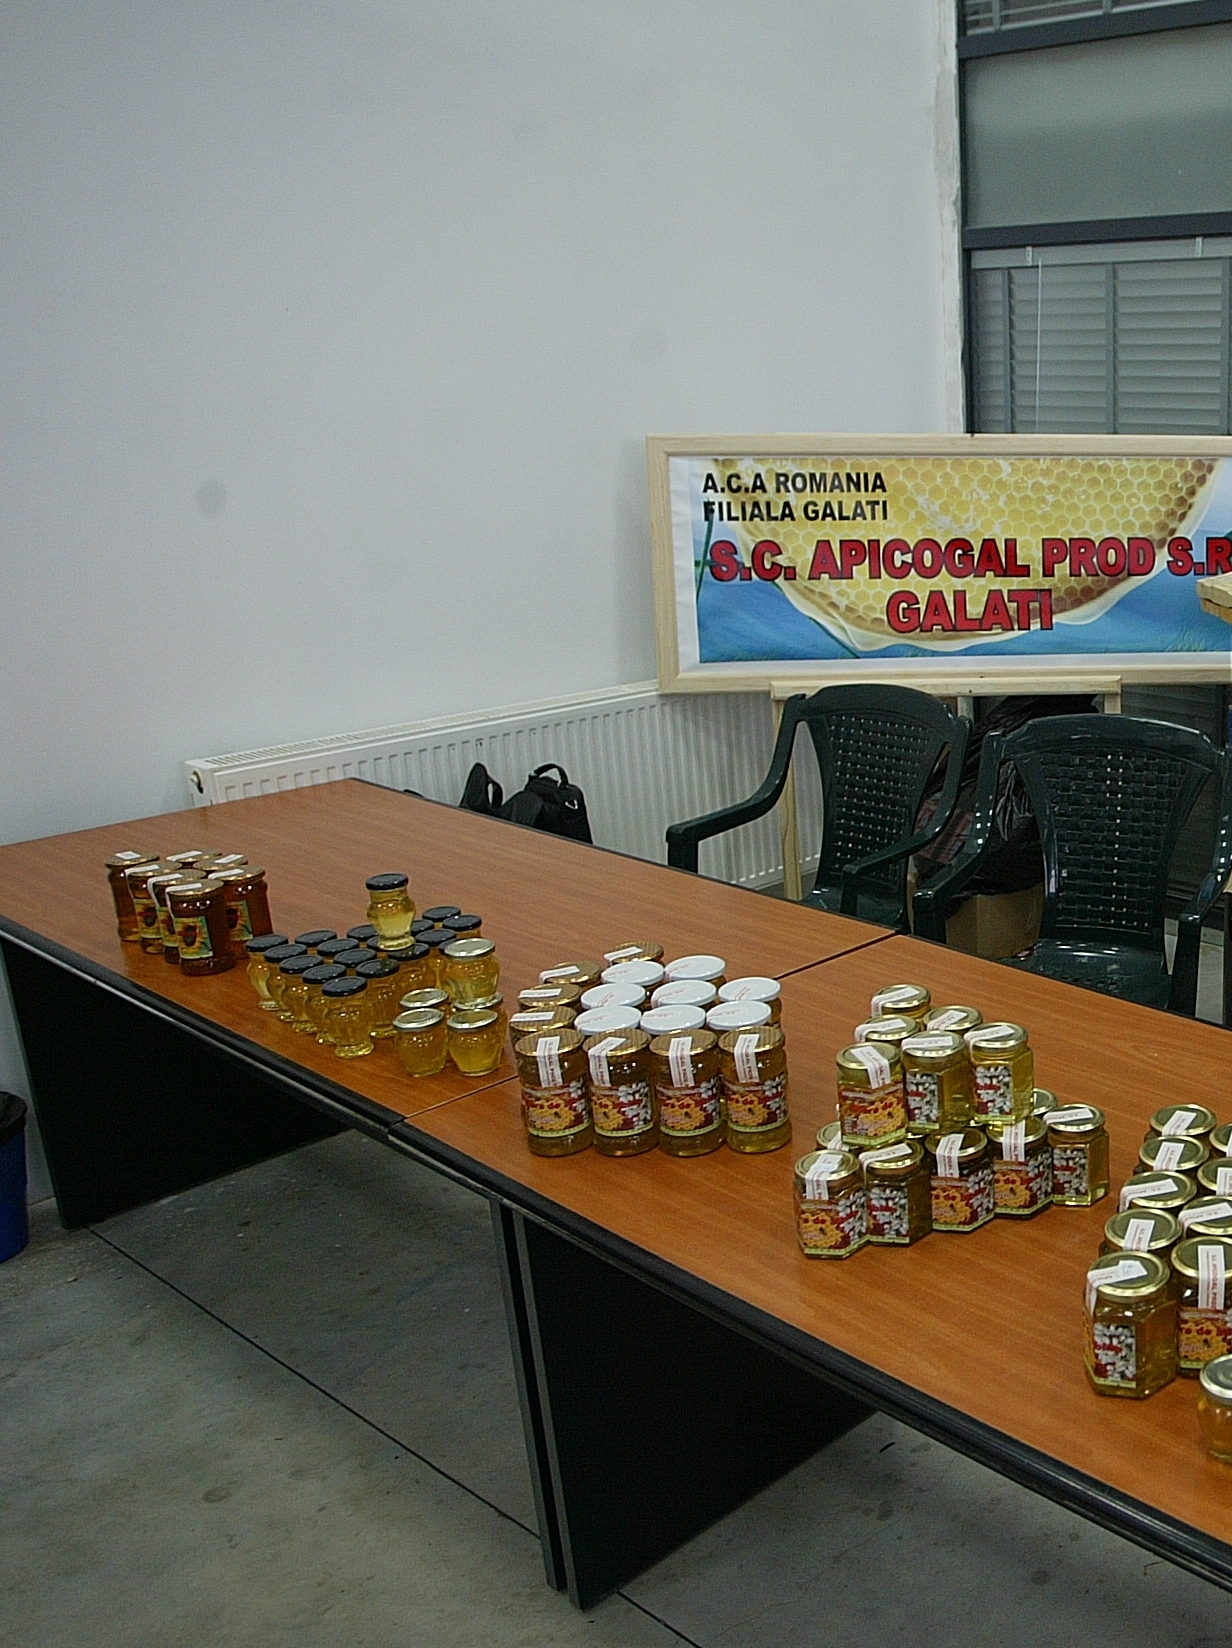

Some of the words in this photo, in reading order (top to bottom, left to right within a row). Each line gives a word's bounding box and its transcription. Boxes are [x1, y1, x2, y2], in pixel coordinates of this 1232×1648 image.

[703, 472, 767, 493] A.C.A
[776, 472, 887, 493] ROMANIA
[703, 501, 796, 522] FILIALA
[803, 500, 888, 521] GALATI
[709, 538, 797, 582] S.C.
[808, 538, 1030, 580] APICOGAL
[1042, 536, 1156, 577] PROD
[886, 589, 1053, 633] GALATI
